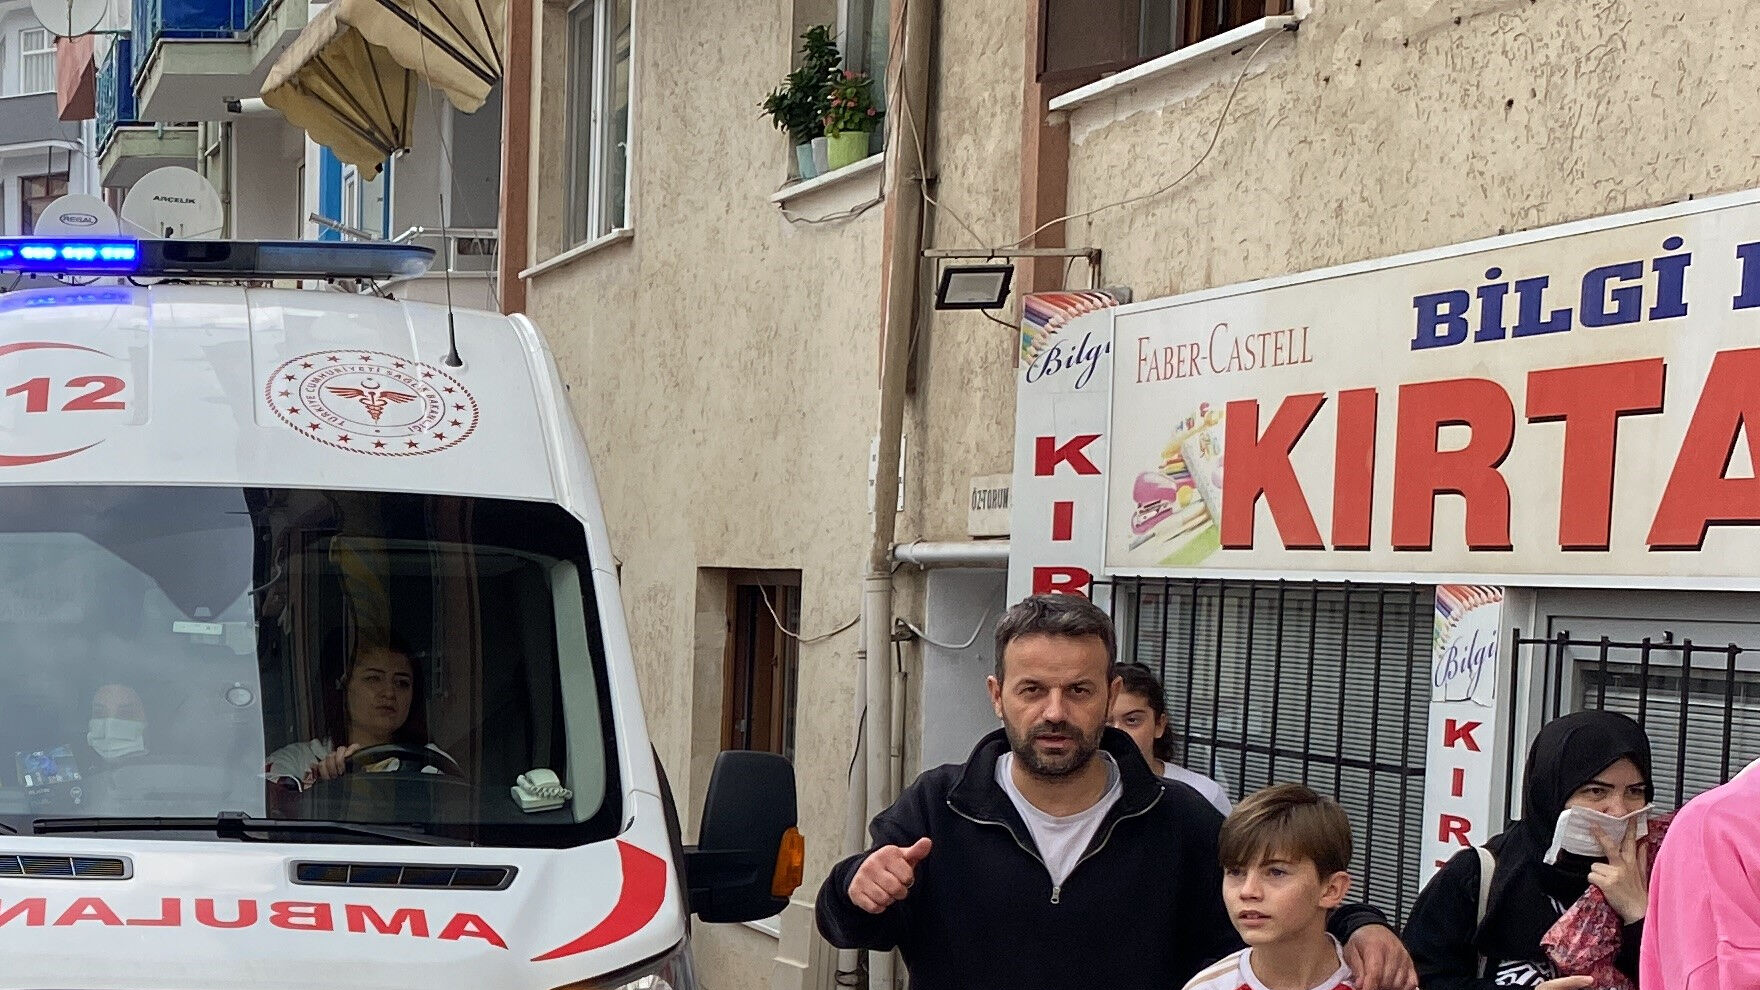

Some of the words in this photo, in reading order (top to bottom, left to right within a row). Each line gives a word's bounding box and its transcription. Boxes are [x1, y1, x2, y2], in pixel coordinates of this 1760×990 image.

[63, 215, 94, 224] REGAL
[1411, 236, 1692, 351] BİLGİ
[1434, 628, 1497, 699] Bilgi
[1434, 718, 1483, 869] KIR
